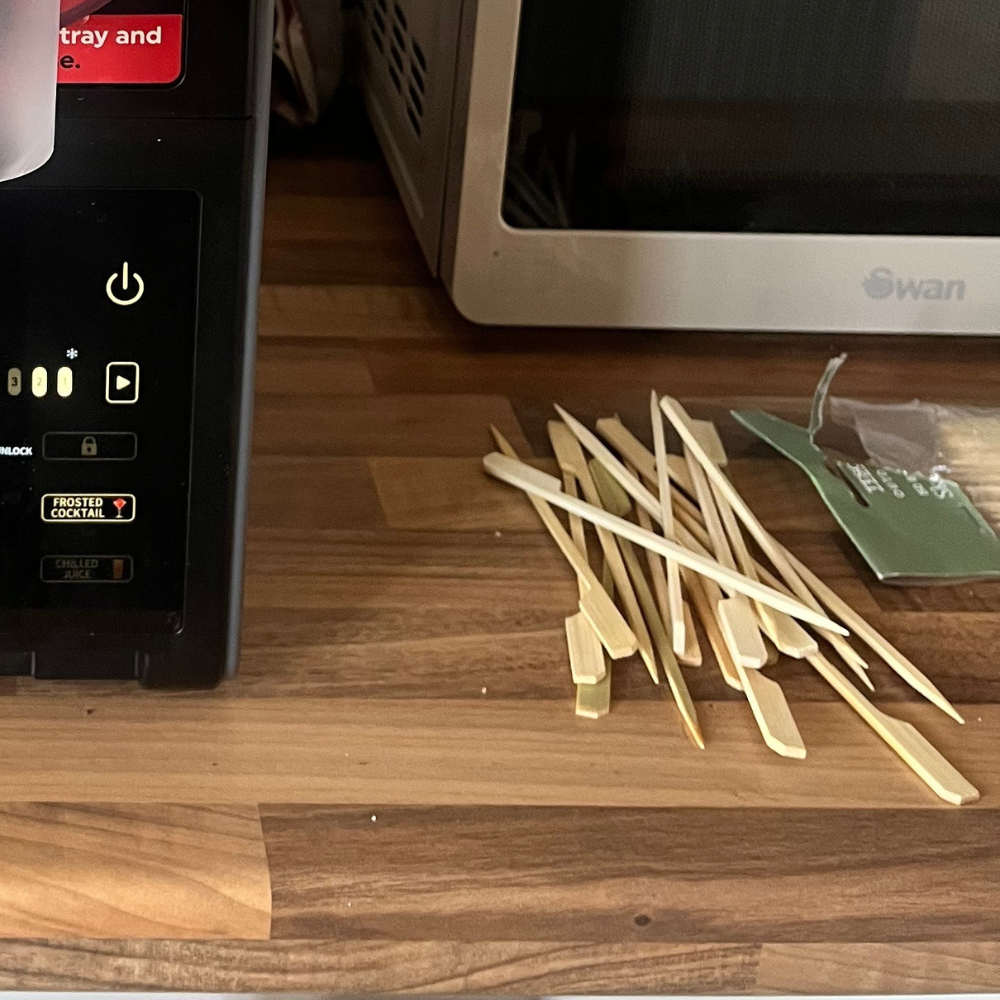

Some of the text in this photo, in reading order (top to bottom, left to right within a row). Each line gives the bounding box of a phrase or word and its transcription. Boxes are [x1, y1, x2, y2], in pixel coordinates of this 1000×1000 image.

[59, 26, 109, 49] tray
[115, 25, 162, 45] and
[11, 377, 19, 387] 3
[53, 497, 103, 508] FROSTED
[50, 508, 105, 519] COCKTAIL
